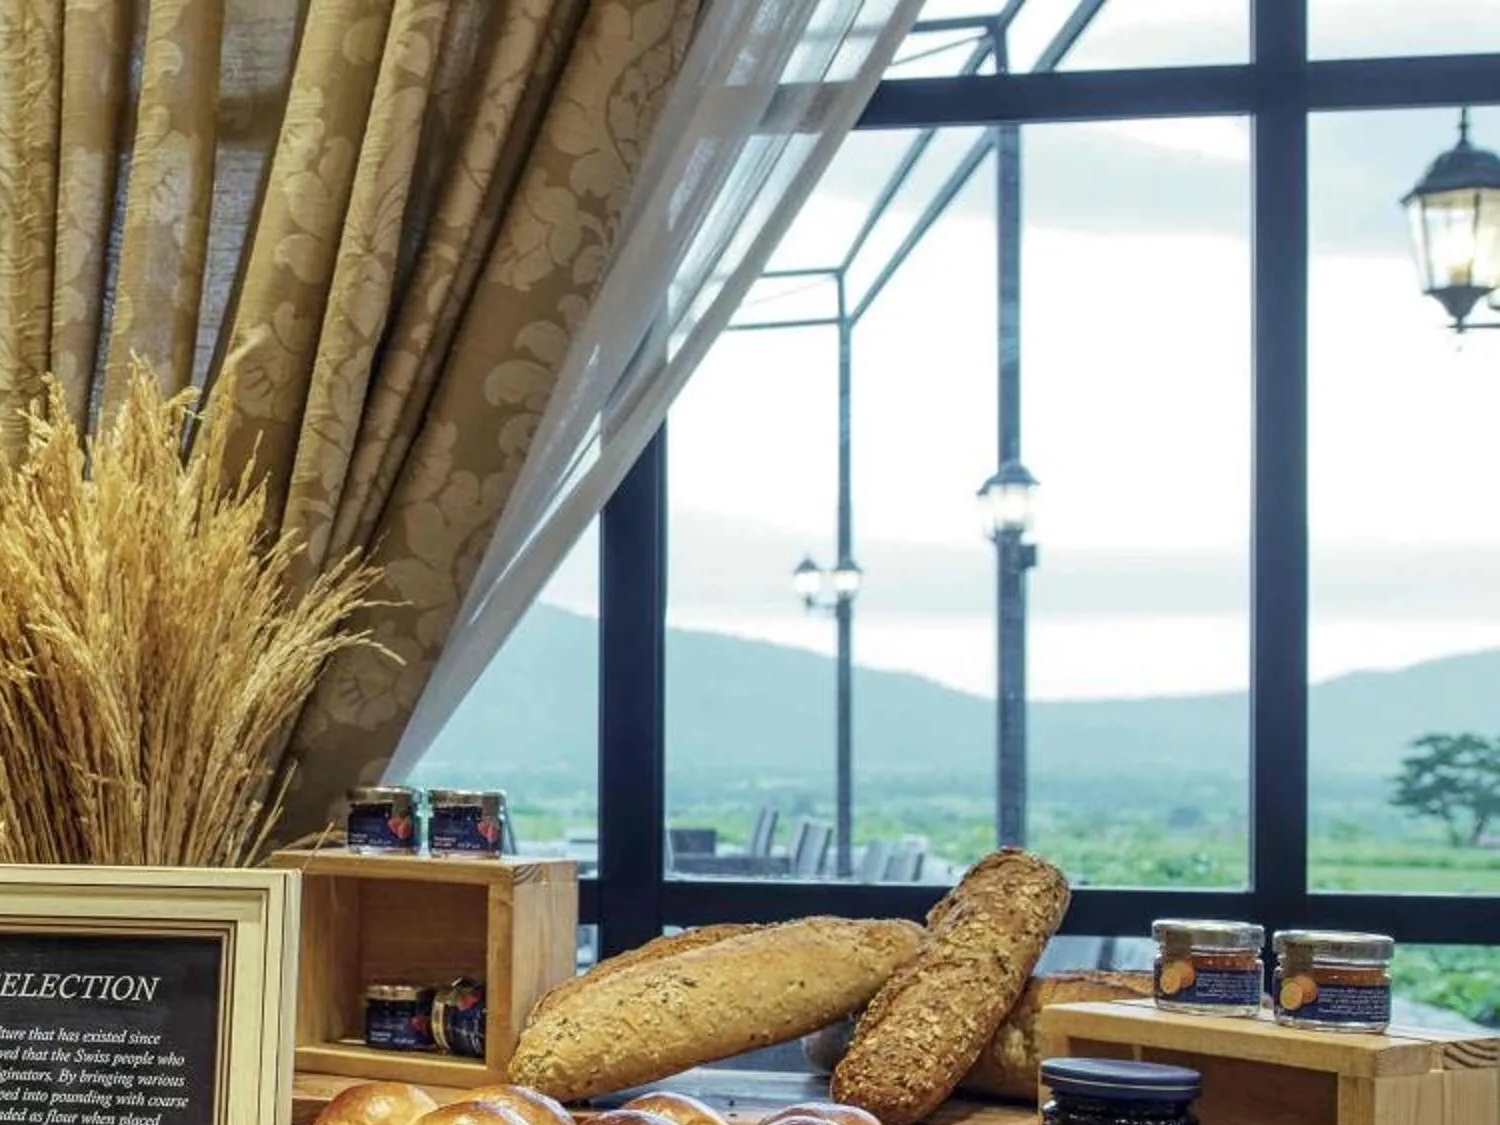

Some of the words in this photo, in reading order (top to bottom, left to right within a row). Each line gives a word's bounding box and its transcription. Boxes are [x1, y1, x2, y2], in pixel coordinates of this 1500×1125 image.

[28, 1026, 54, 1041] that
[57, 1028, 80, 1042] has
[82, 1029, 128, 1043] existed
[127, 1031, 161, 1045] since
[21, 1047, 49, 1061] that
[51, 1048, 71, 1063] the
[74, 1048, 111, 1063] Swiss
[111, 1052, 155, 1068] people
[157, 1052, 185, 1066] who
[57, 1068, 76, 1085] By
[79, 1069, 134, 1087] bringing
[137, 1073, 186, 1087] various
[22, 1088, 49, 1101] into
[50, 1090, 113, 1108] pounding
[115, 1092, 145, 1106] with
[29, 1110, 43, 1122] as
[43, 1109, 79, 1125] flour
[81, 1111, 116, 1125] when
